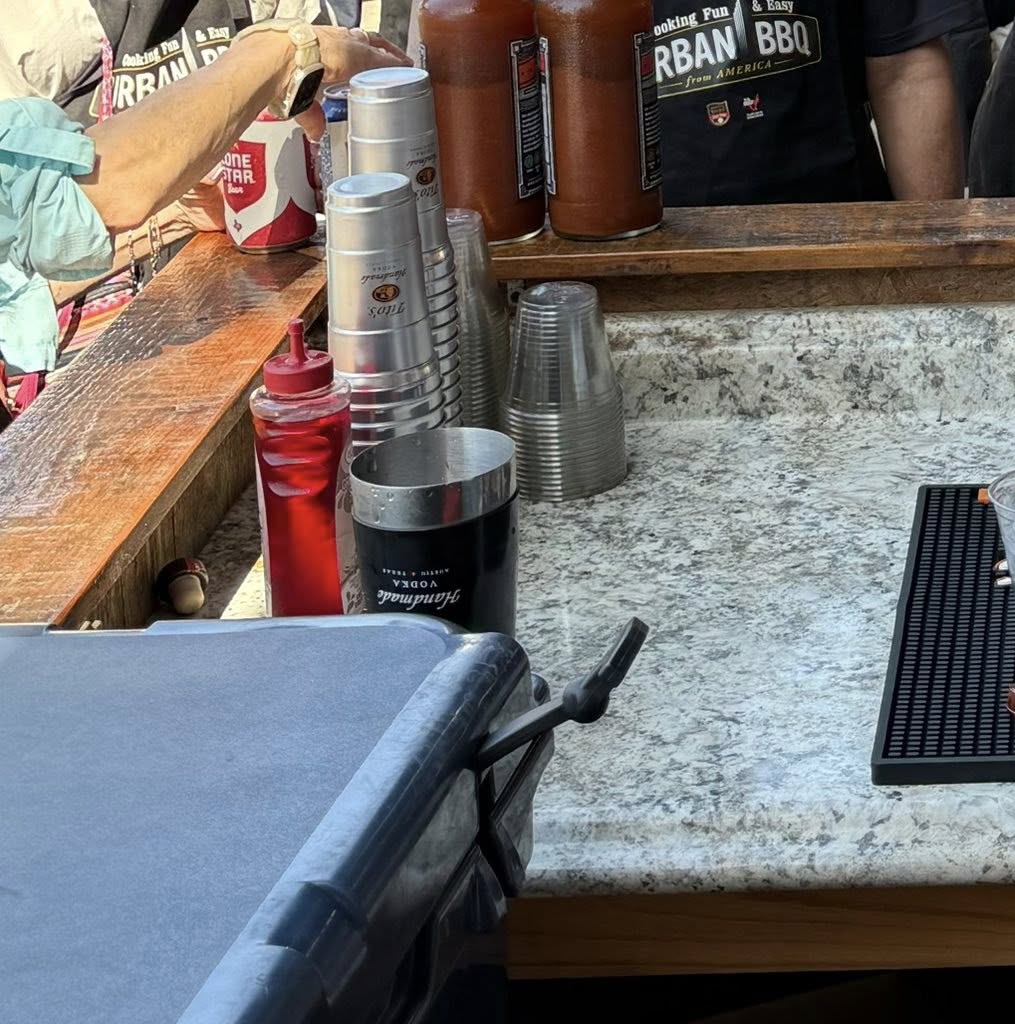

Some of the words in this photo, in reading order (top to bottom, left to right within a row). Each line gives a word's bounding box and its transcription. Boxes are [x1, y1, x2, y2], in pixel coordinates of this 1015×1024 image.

[654, 11, 698, 37] ooking
[702, 5, 730, 22] Fun
[752, 0, 763, 12] &
[160, 39, 180, 56] Fun
[195, 29, 206, 43] &
[207, 26, 230, 40] Easy
[654, 26, 737, 83] RBAN
[754, 20, 812, 57] BBQ
[685, 73, 712, 88] from
[717, 60, 772, 78] AMERICA
[368, 301, 405, 318] Tito's
[393, 579, 437, 588] VODKA
[377, 589, 461, 611] Handmade
